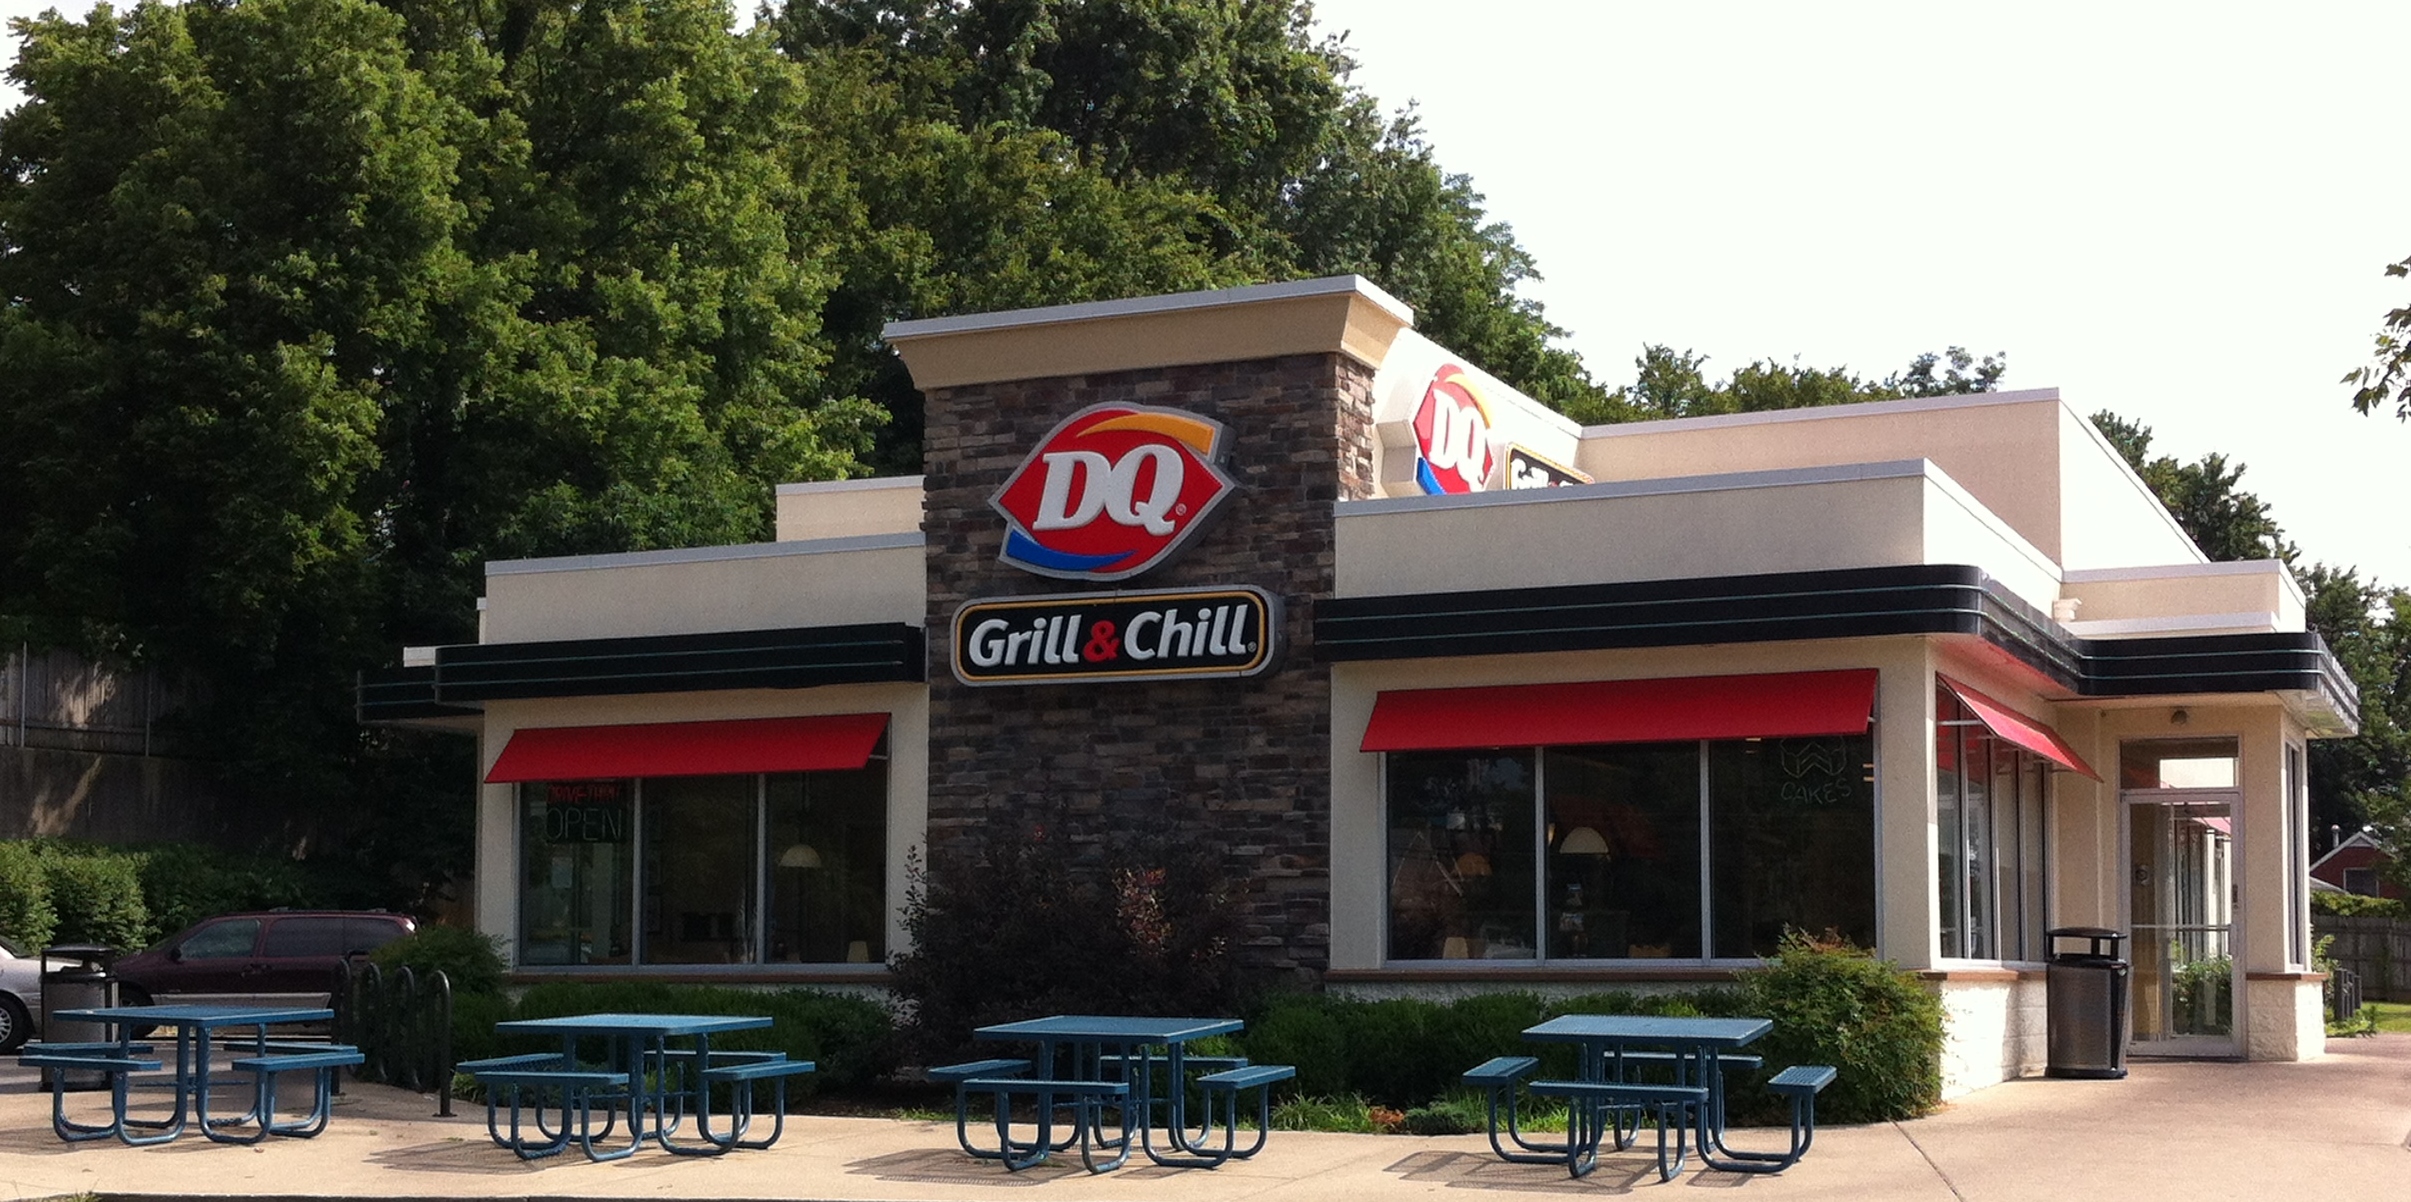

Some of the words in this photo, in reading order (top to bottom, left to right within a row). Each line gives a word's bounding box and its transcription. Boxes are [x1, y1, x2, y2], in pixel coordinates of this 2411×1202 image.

[1032, 444, 1184, 536] DQ
[1780, 777, 1852, 805] CAKES
[544, 807, 622, 841] OPEN
